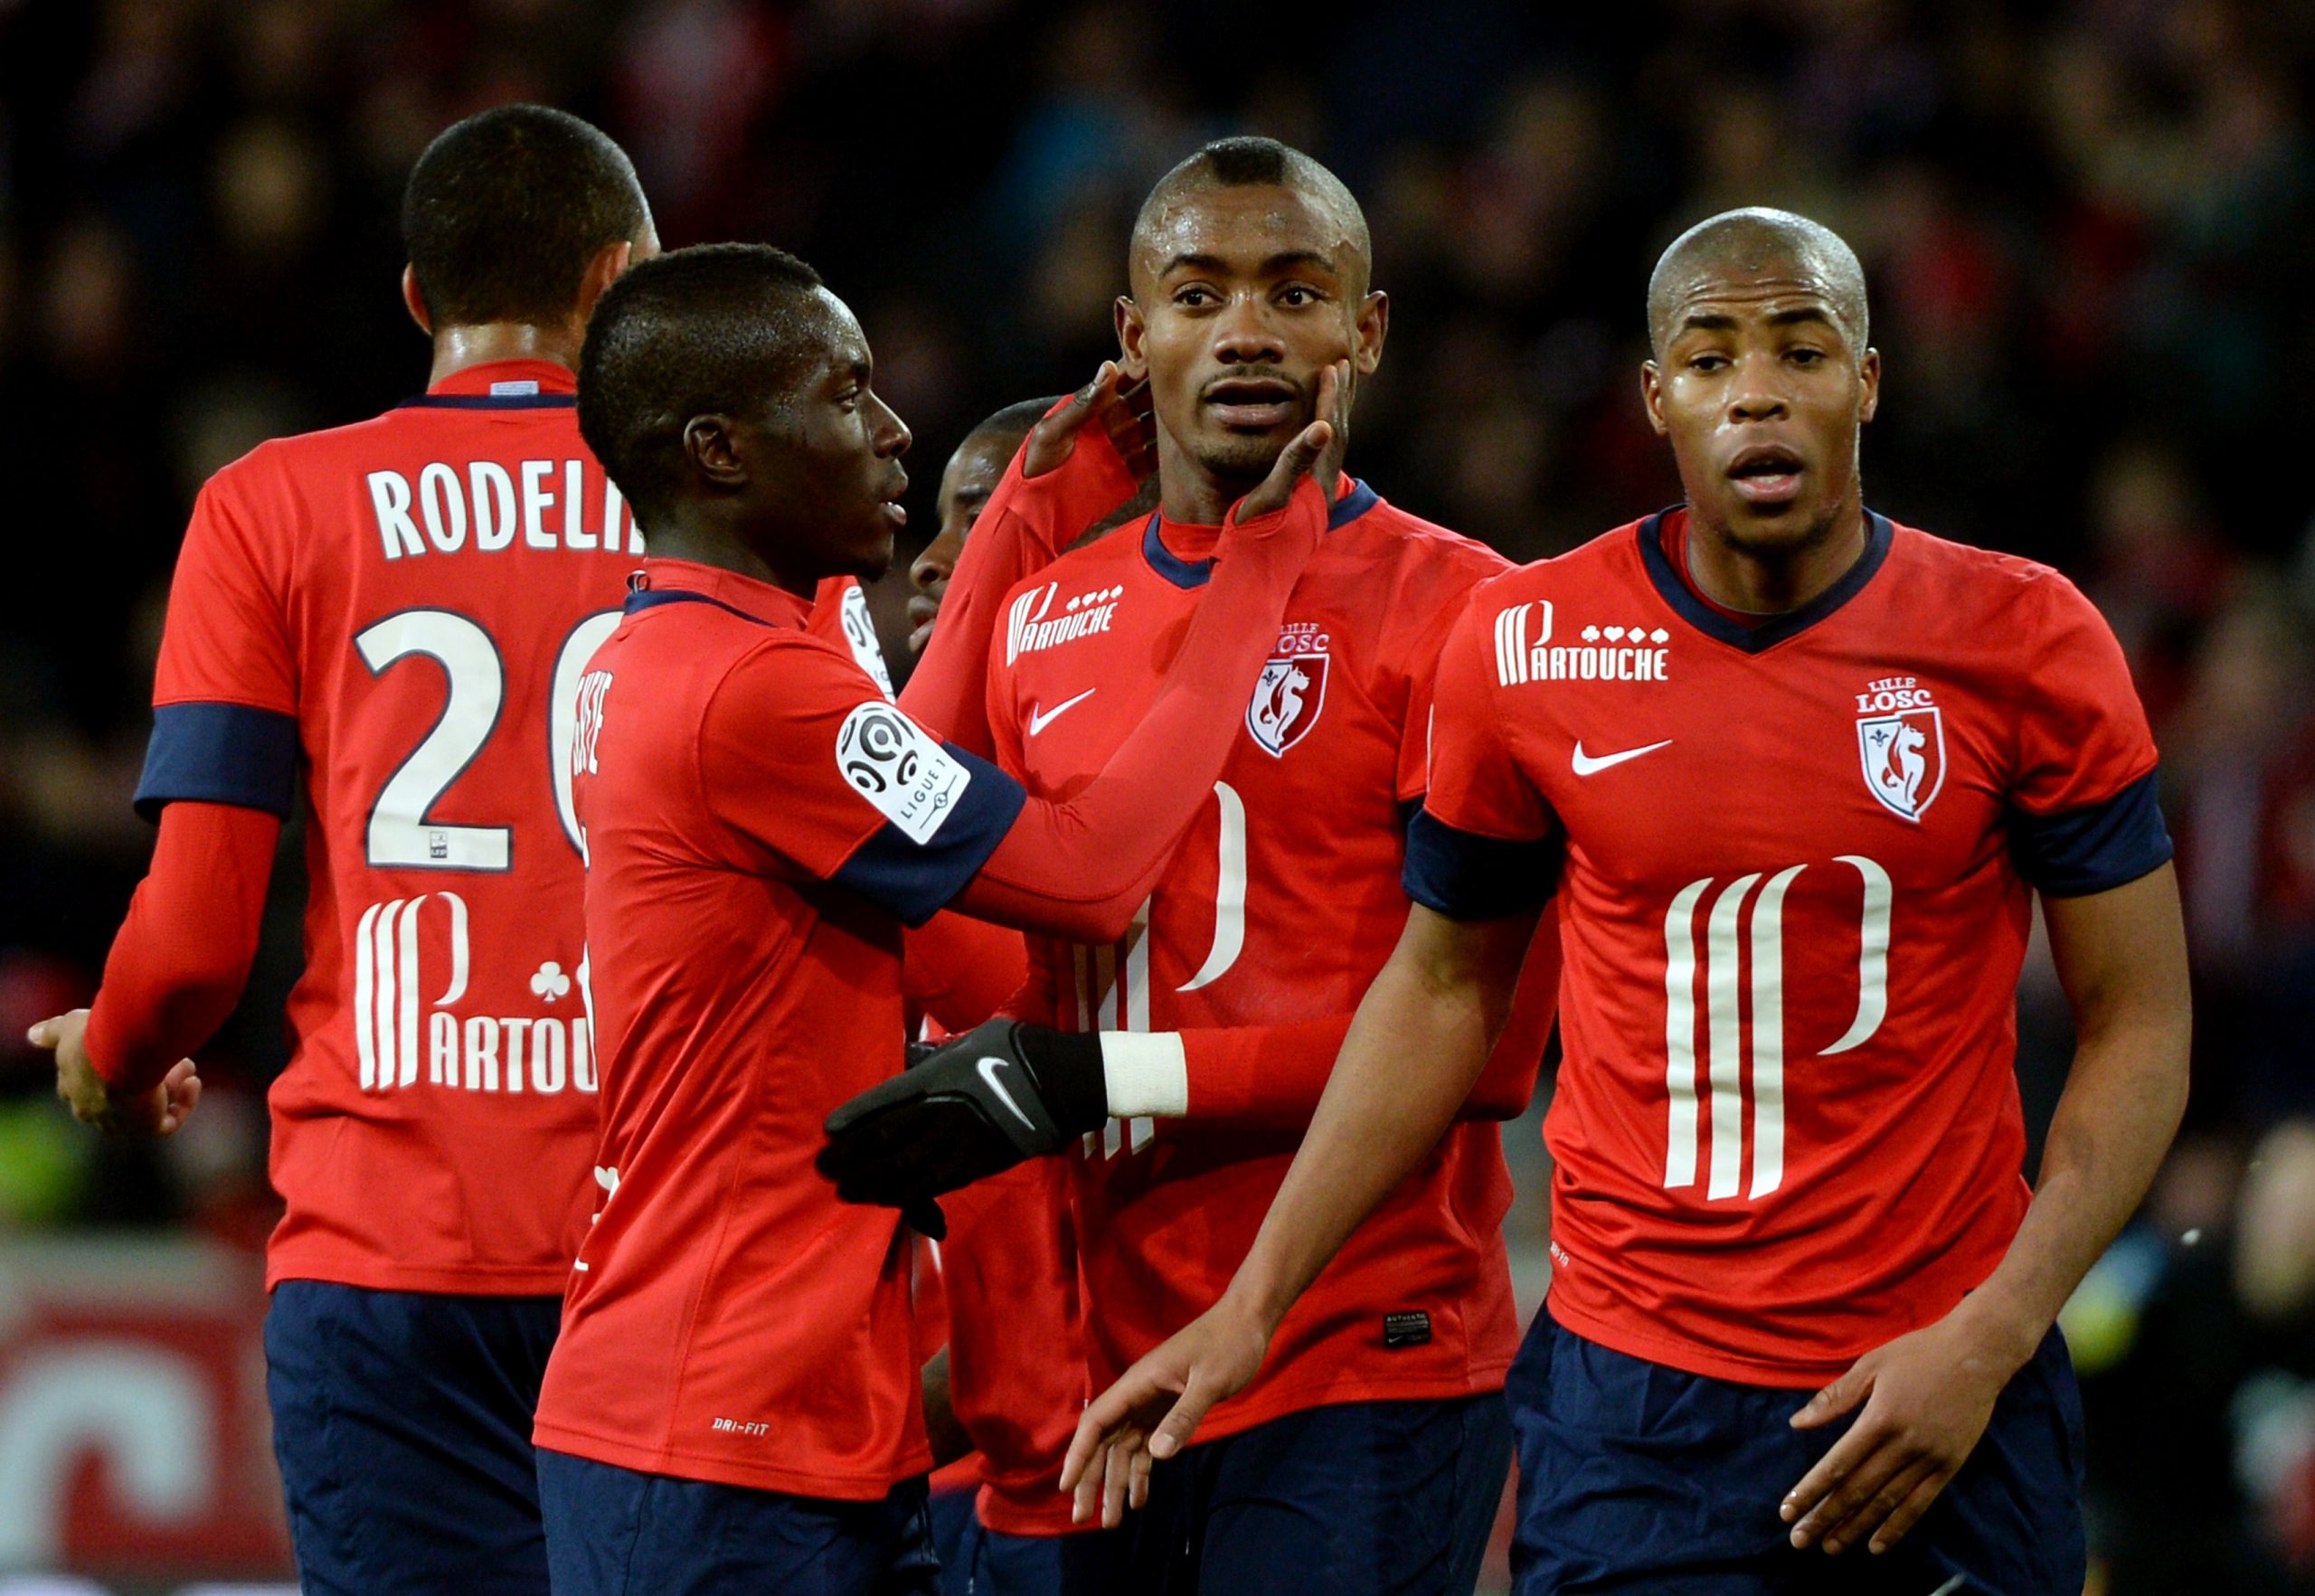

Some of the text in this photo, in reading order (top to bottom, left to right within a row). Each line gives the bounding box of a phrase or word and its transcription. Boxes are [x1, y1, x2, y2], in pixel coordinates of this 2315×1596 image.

[1006, 581, 1119, 667] PARTOUCHE
[1271, 634, 1330, 654] OSC
[1494, 600, 1670, 687] PARTOUCHE
[1867, 677, 1917, 694] LILLE
[1856, 689, 1934, 713] LOSC
[901, 758, 946, 820] LIGUE 1
[711, 1416, 770, 1437] DRI-FIT
